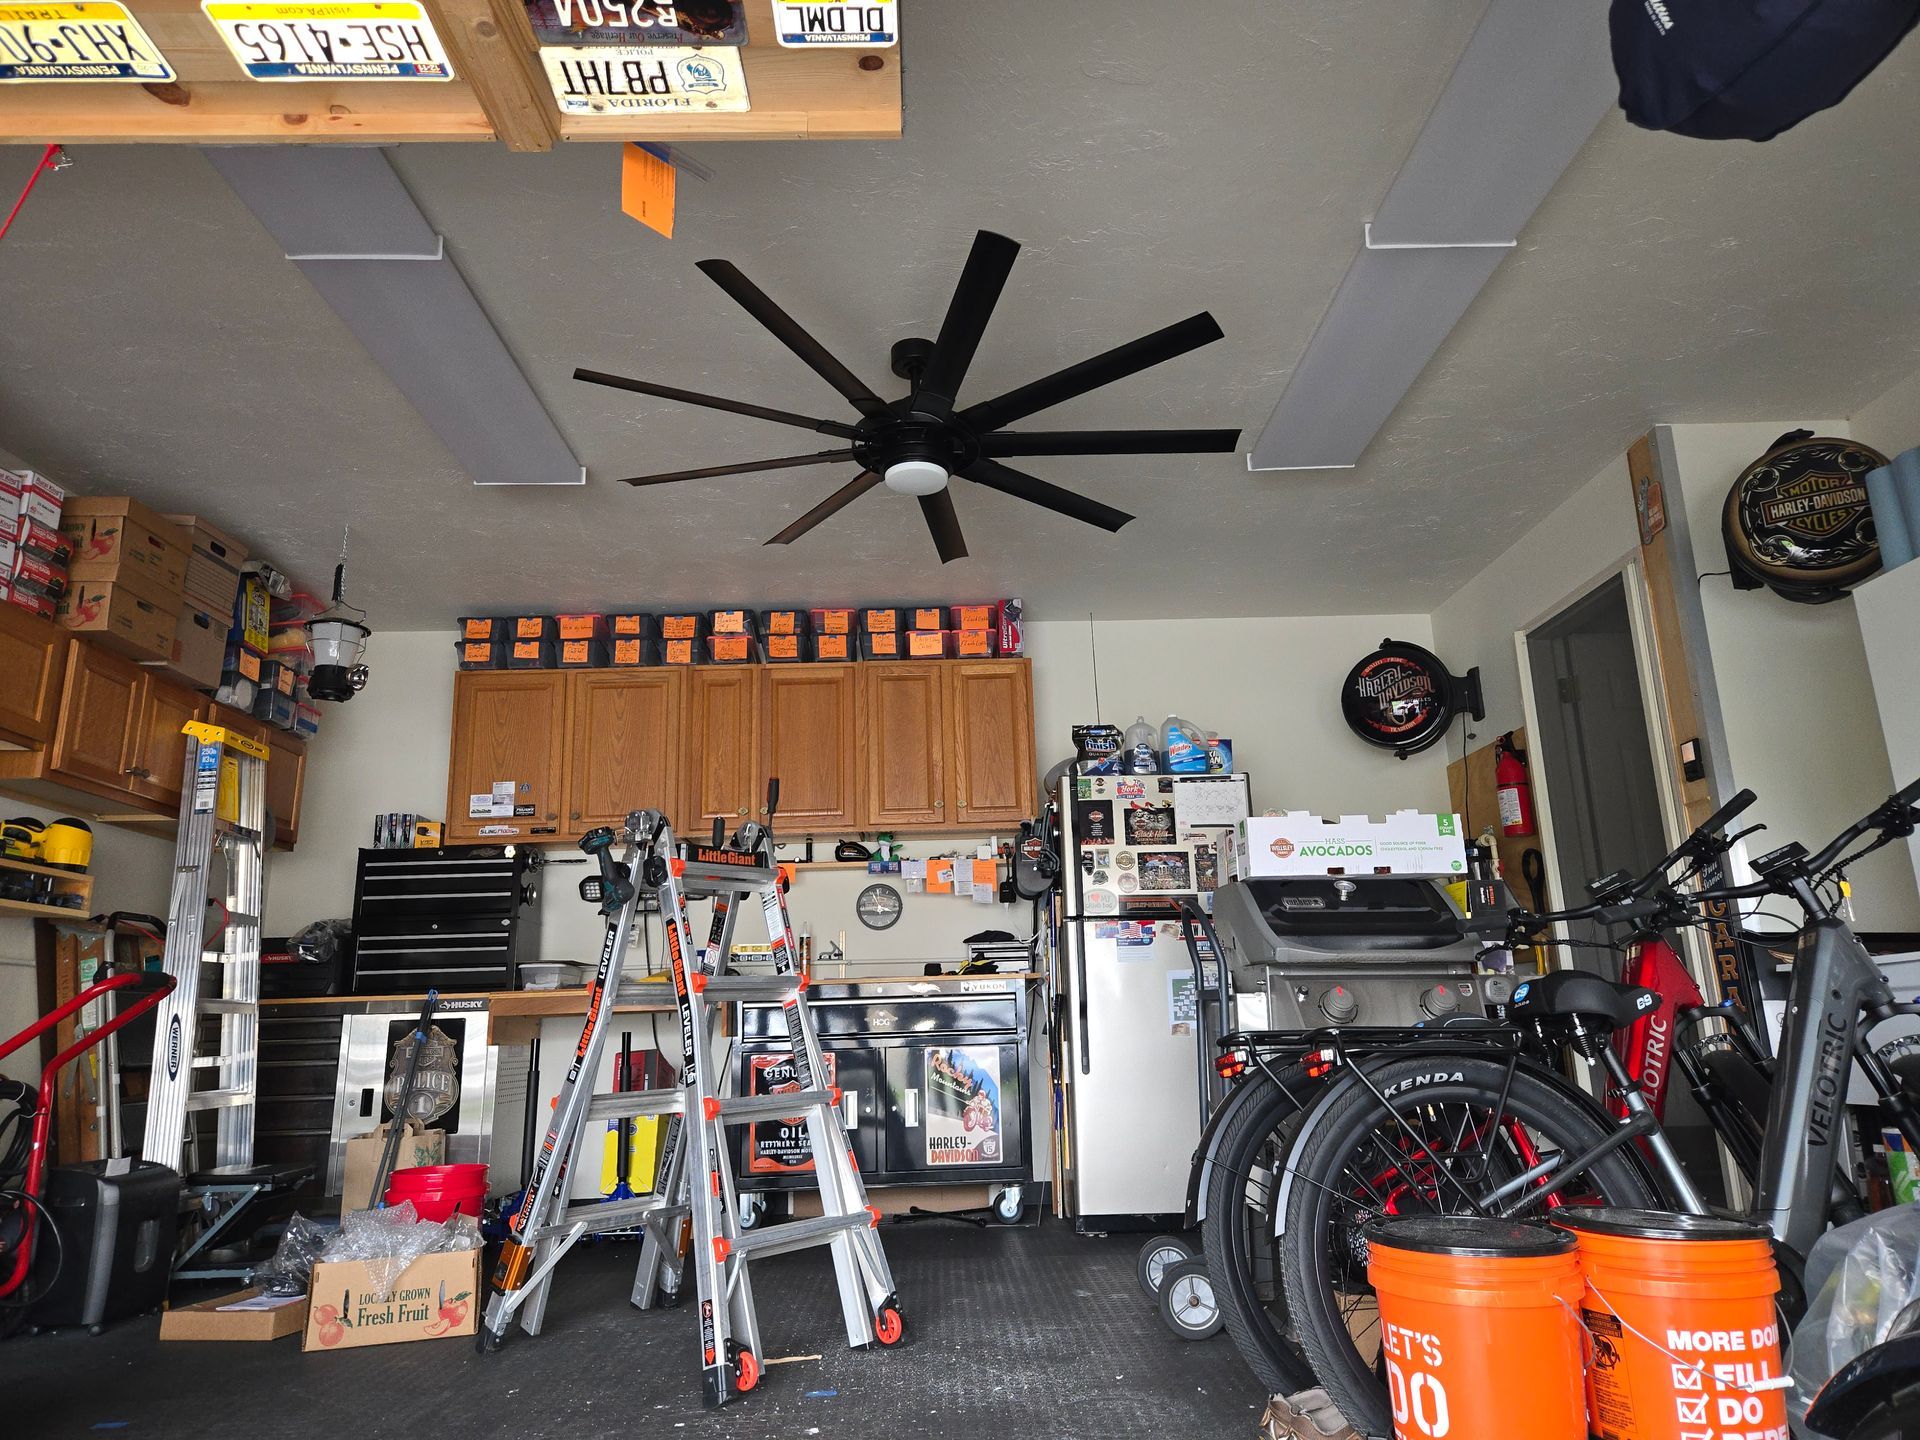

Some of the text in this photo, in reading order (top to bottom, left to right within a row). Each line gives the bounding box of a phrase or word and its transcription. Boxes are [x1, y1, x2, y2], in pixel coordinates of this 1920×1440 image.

[276, 7, 352, 16] visitPA.com
[786, 7, 884, 32] DLDML
[591, 31, 683, 42] Preserve Our Heritage
[805, 34, 870, 42] PENNSYLVANIA
[15, 65, 119, 76] PENNSYLVANIA
[295, 64, 399, 75] PENNSYLVANIA
[559, 60, 671, 96] PB7HT
[607, 98, 691, 107] FLORIDA
[1789, 477, 1843, 496] MOTOR
[1770, 488, 1866, 518] HARLEY-DAVIDSON
[1796, 509, 1847, 530] CYCLES
[1355, 666, 1402, 698] HARLEY
[1379, 672, 1435, 710] DAVIDSON
[1085, 738, 1116, 750] finish
[1169, 744, 1192, 756] Windex
[1121, 785, 1138, 793] York
[1299, 845, 1373, 857] AVOCADOS
[1325, 837, 1346, 845] HASS
[599, 930, 615, 980] LEVELER
[451, 1000, 483, 1010] HUSKY
[681, 1002, 695, 1058] LEVELER
[873, 1018, 890, 1026] HOG
[171, 1026, 179, 1069] WERNER
[763, 1067, 799, 1079] GENU
[932, 1053, 974, 1089] Rocky
[1643, 1017, 1672, 1116] LOTRIC
[396, 1071, 449, 1094] PLICE
[931, 1072, 972, 1097] Mountains
[1383, 1070, 1465, 1099] KENDA
[1808, 1012, 1848, 1147] VELOTRIC
[416, 1095, 427, 1113] 1
[780, 1127, 806, 1139] OIL
[929, 1135, 972, 1150] HARLEY-
[798, 1140, 811, 1148] SEA
[931, 1148, 980, 1163] DAVIDSON
[399, 1287, 431, 1300] GROWN
[357, 1304, 429, 1327] Fresh Fruit
[1381, 1317, 1443, 1367] LET'S
[1666, 1329, 1746, 1352] MORE
[1714, 1361, 1769, 1391] FILL
[1386, 1357, 1450, 1438] DO
[1718, 1397, 1764, 1425] DO
